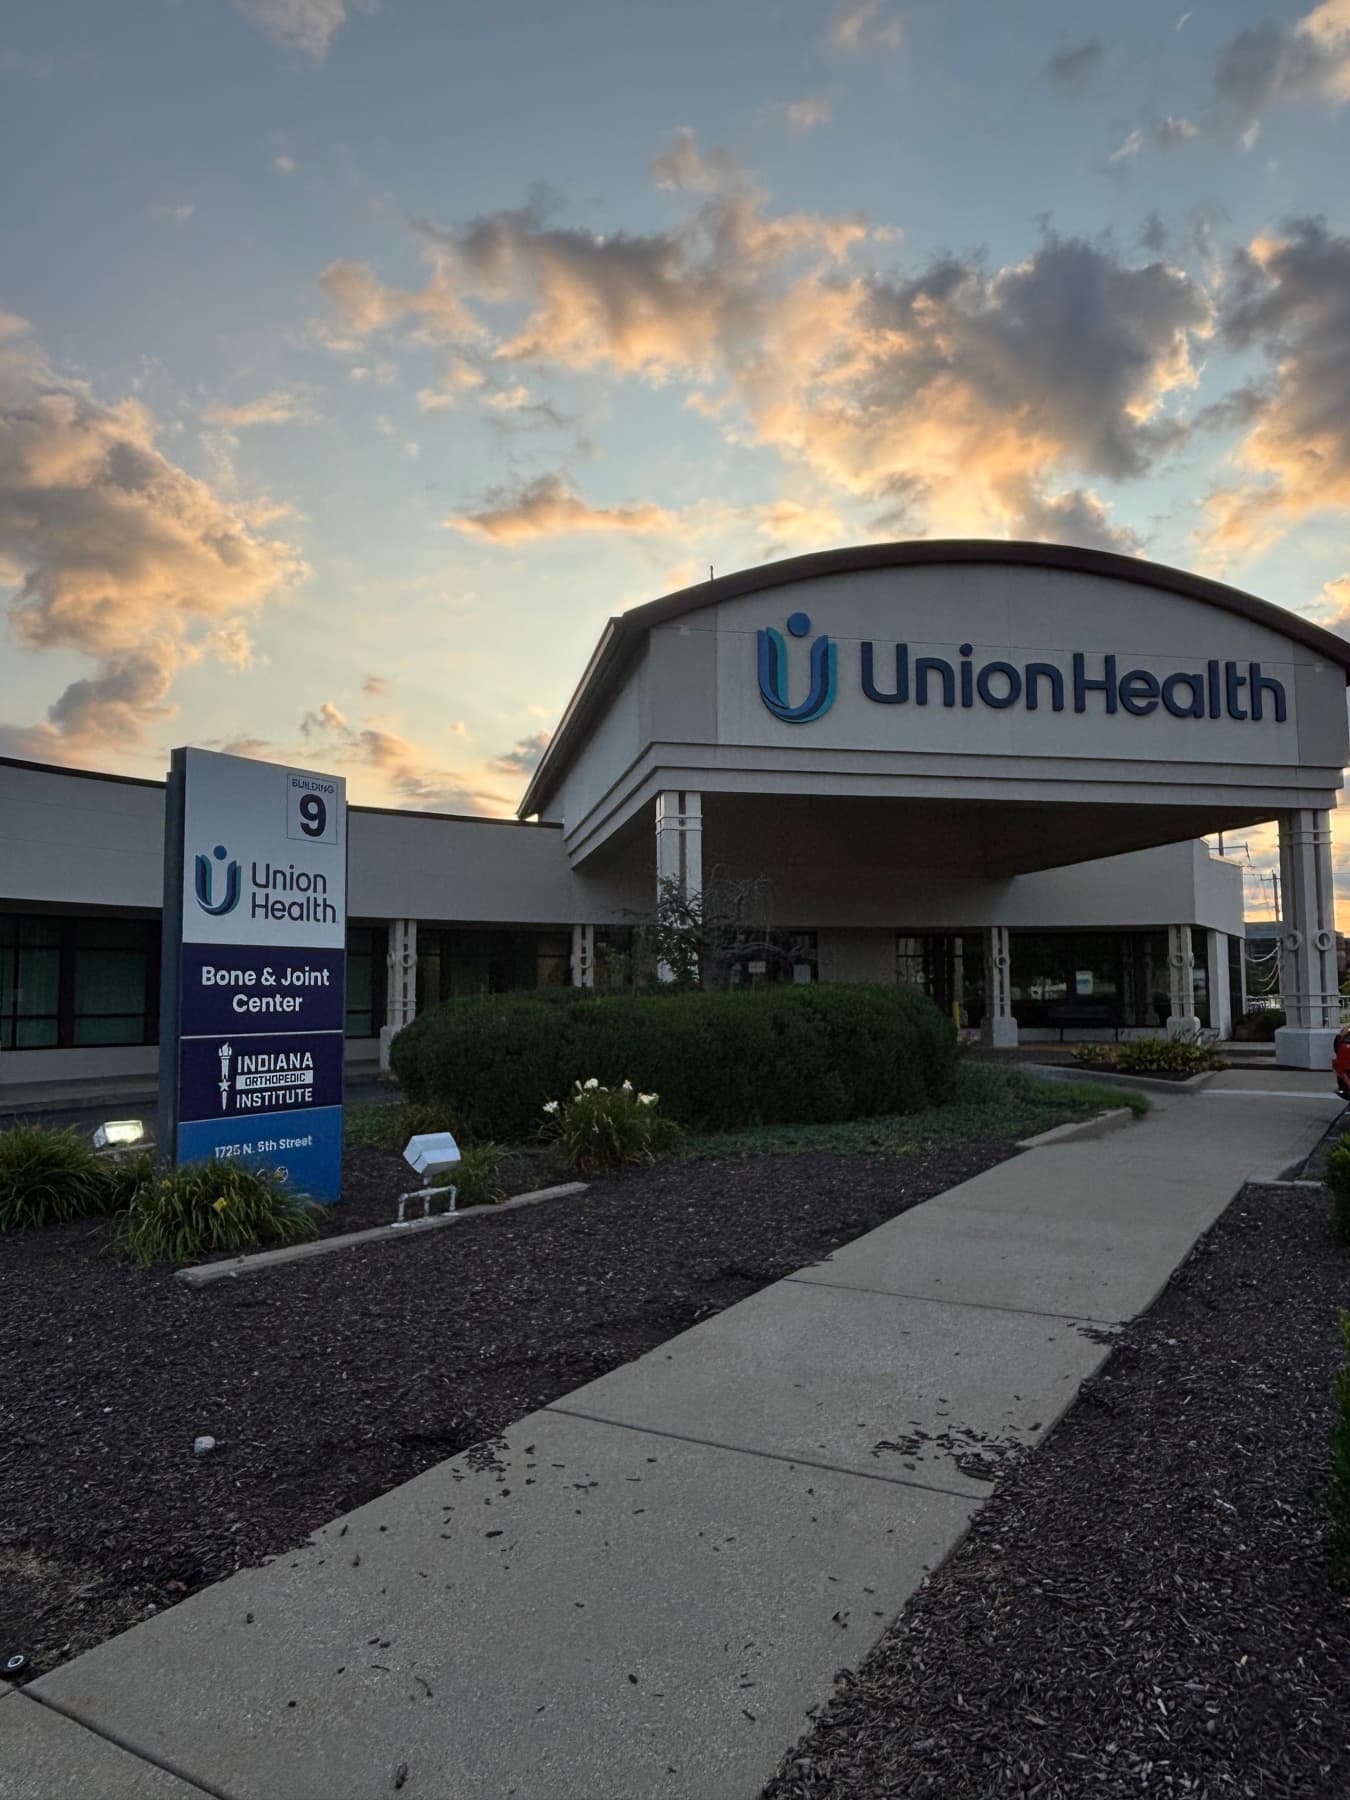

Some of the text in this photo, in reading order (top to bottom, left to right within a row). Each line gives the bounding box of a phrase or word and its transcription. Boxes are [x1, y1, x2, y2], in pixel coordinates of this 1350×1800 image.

[291, 778, 335, 794] BUILDING
[299, 793, 327, 837] 9
[252, 861, 327, 894] Union
[251, 892, 337, 924] Health
[202, 966, 330, 986] Bone & Joint
[232, 994, 303, 1013] Center
[237, 1052, 313, 1073] INDIANA
[244, 1072, 306, 1087] ORTHOPEDIC
[236, 1088, 313, 1109] INSTITUTE
[214, 1135, 313, 1159] 1725 N. 5th Street
